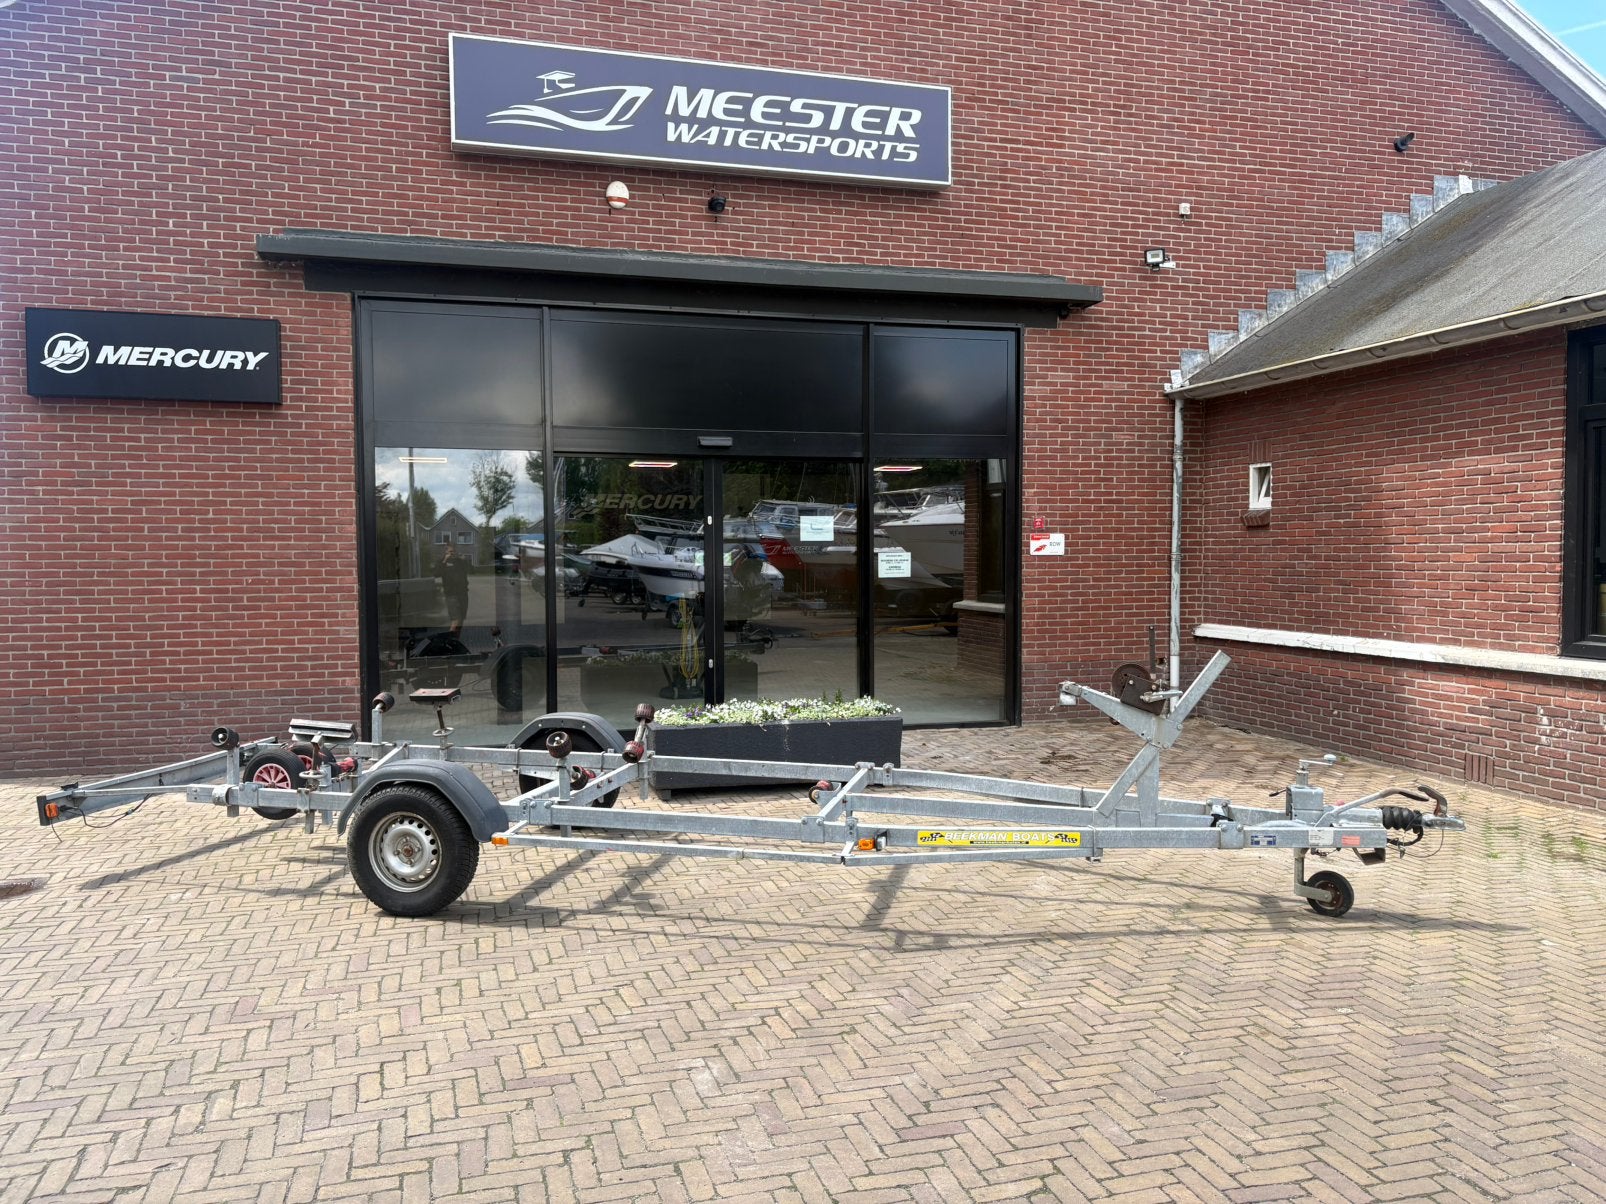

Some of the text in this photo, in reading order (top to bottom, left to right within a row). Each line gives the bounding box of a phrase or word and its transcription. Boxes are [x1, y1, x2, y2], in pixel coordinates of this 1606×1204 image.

[665, 85, 922, 138] MEESTER
[666, 122, 920, 163] WATERSPORTS
[96, 345, 269, 371] MERCURY
[944, 831, 1056, 841] BEEKMAN BOATS
